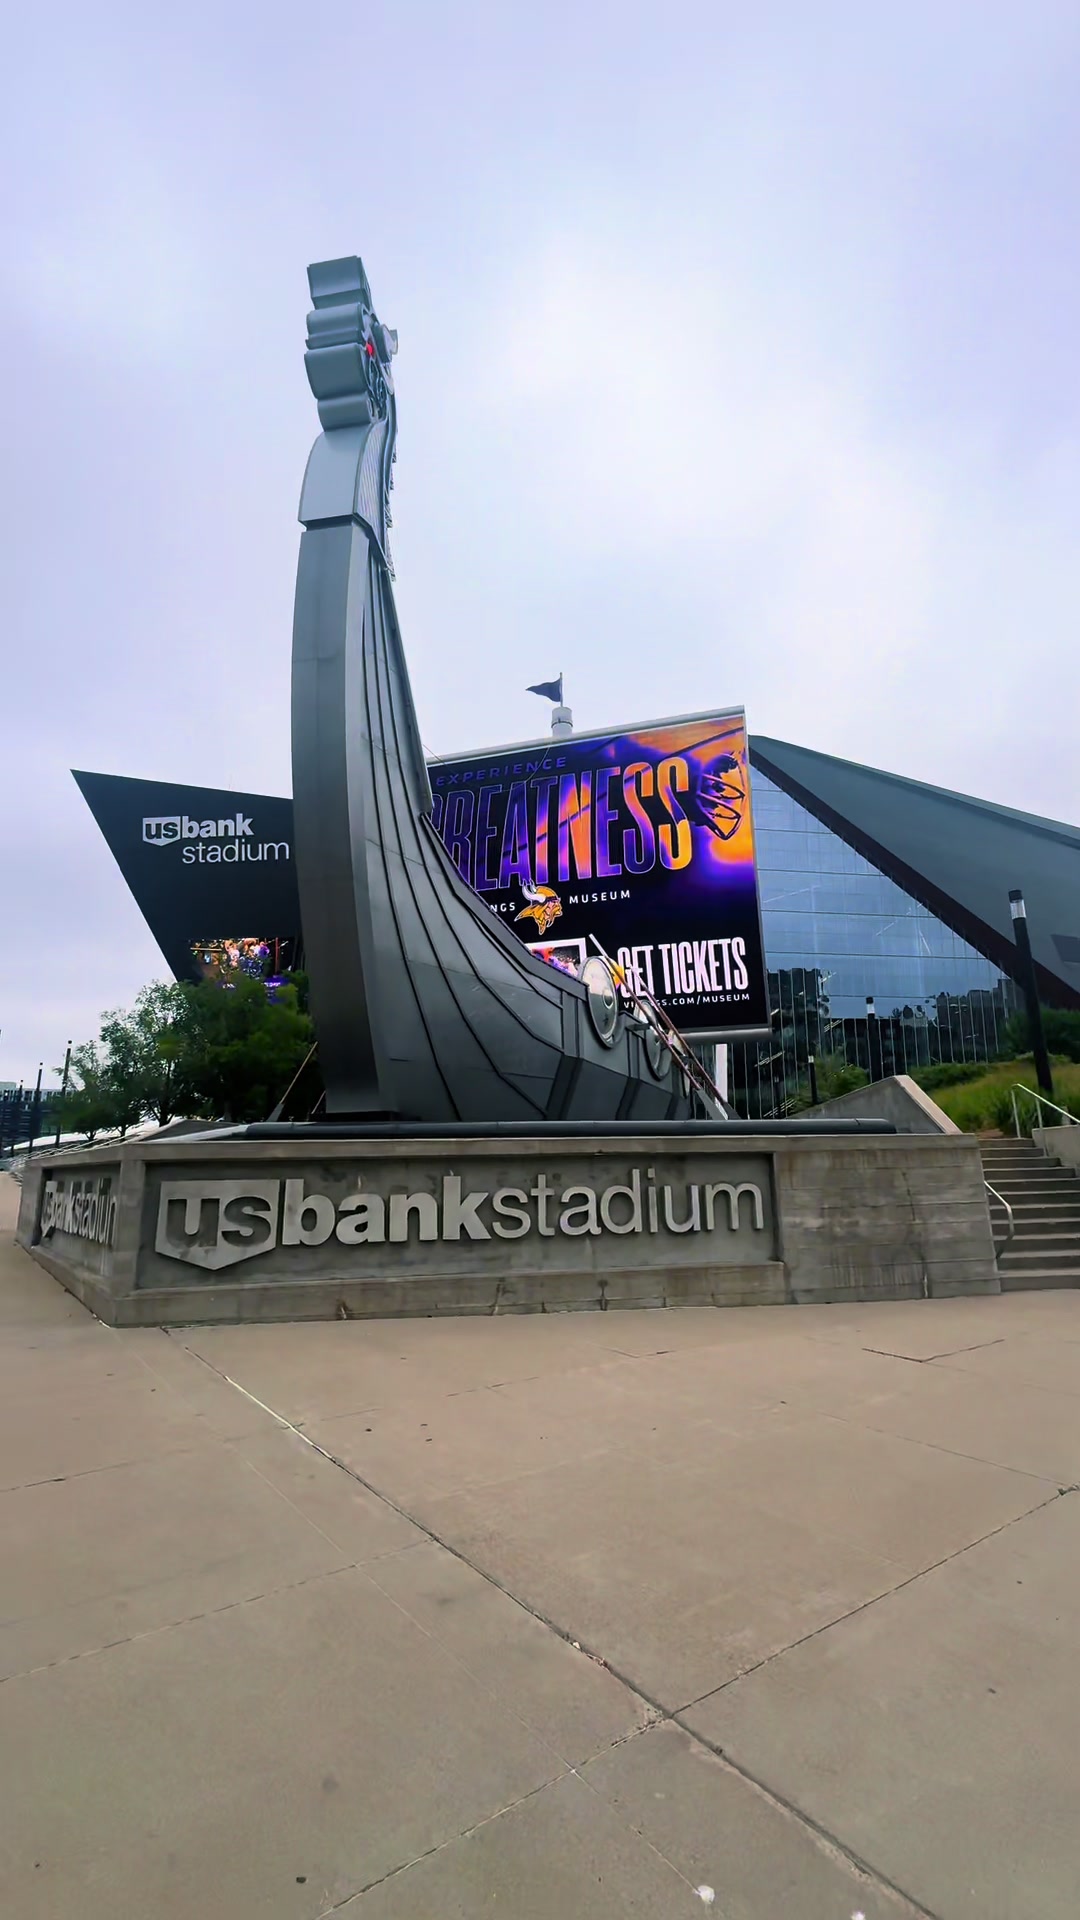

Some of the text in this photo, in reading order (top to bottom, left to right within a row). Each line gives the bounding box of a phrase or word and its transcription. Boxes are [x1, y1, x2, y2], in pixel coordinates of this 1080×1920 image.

[436, 756, 567, 787] EXPERIENCE
[431, 757, 693, 892] REATNESS
[182, 839, 290, 865] stadium
[569, 889, 631, 904] MUSEUM
[617, 936, 749, 999] GET TICKETS
